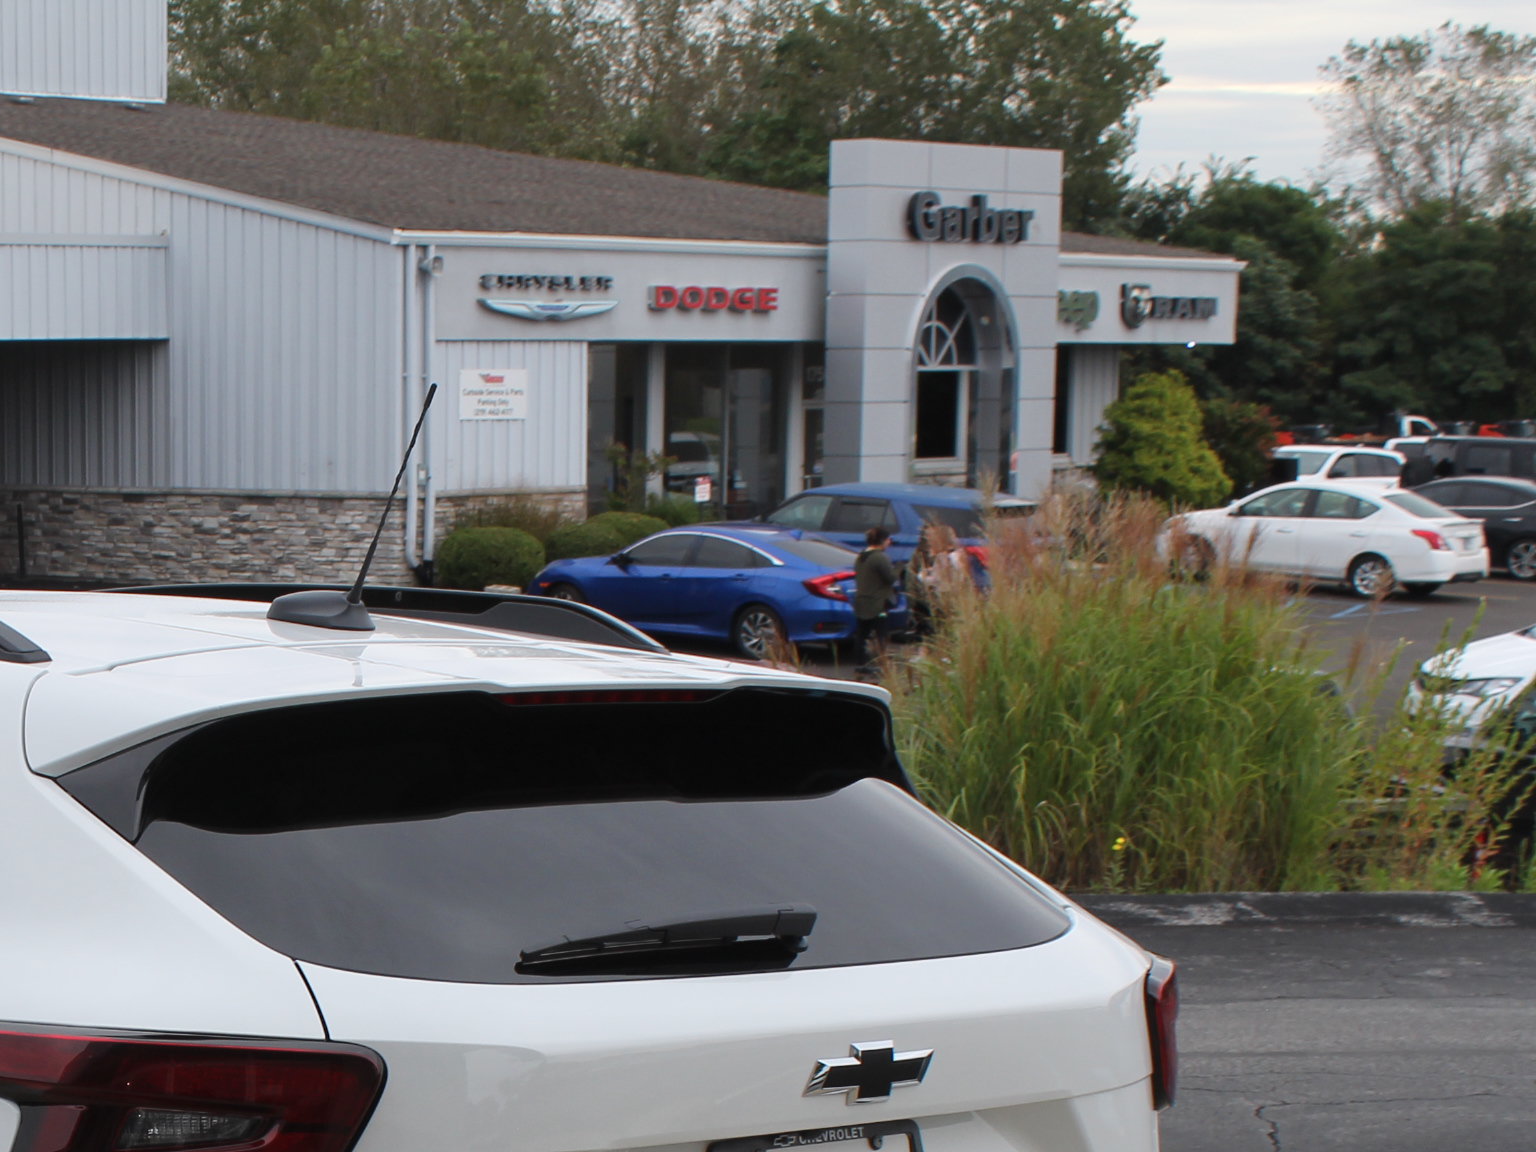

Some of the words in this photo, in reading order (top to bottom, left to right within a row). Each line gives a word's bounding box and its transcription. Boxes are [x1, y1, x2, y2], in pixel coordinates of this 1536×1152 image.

[907, 190, 1035, 243] Garber
[479, 274, 614, 291] CHRYSLER
[650, 285, 779, 312] DODGE
[1151, 297, 1219, 319] RAM
[798, 1126, 865, 1145] CEVROLET
